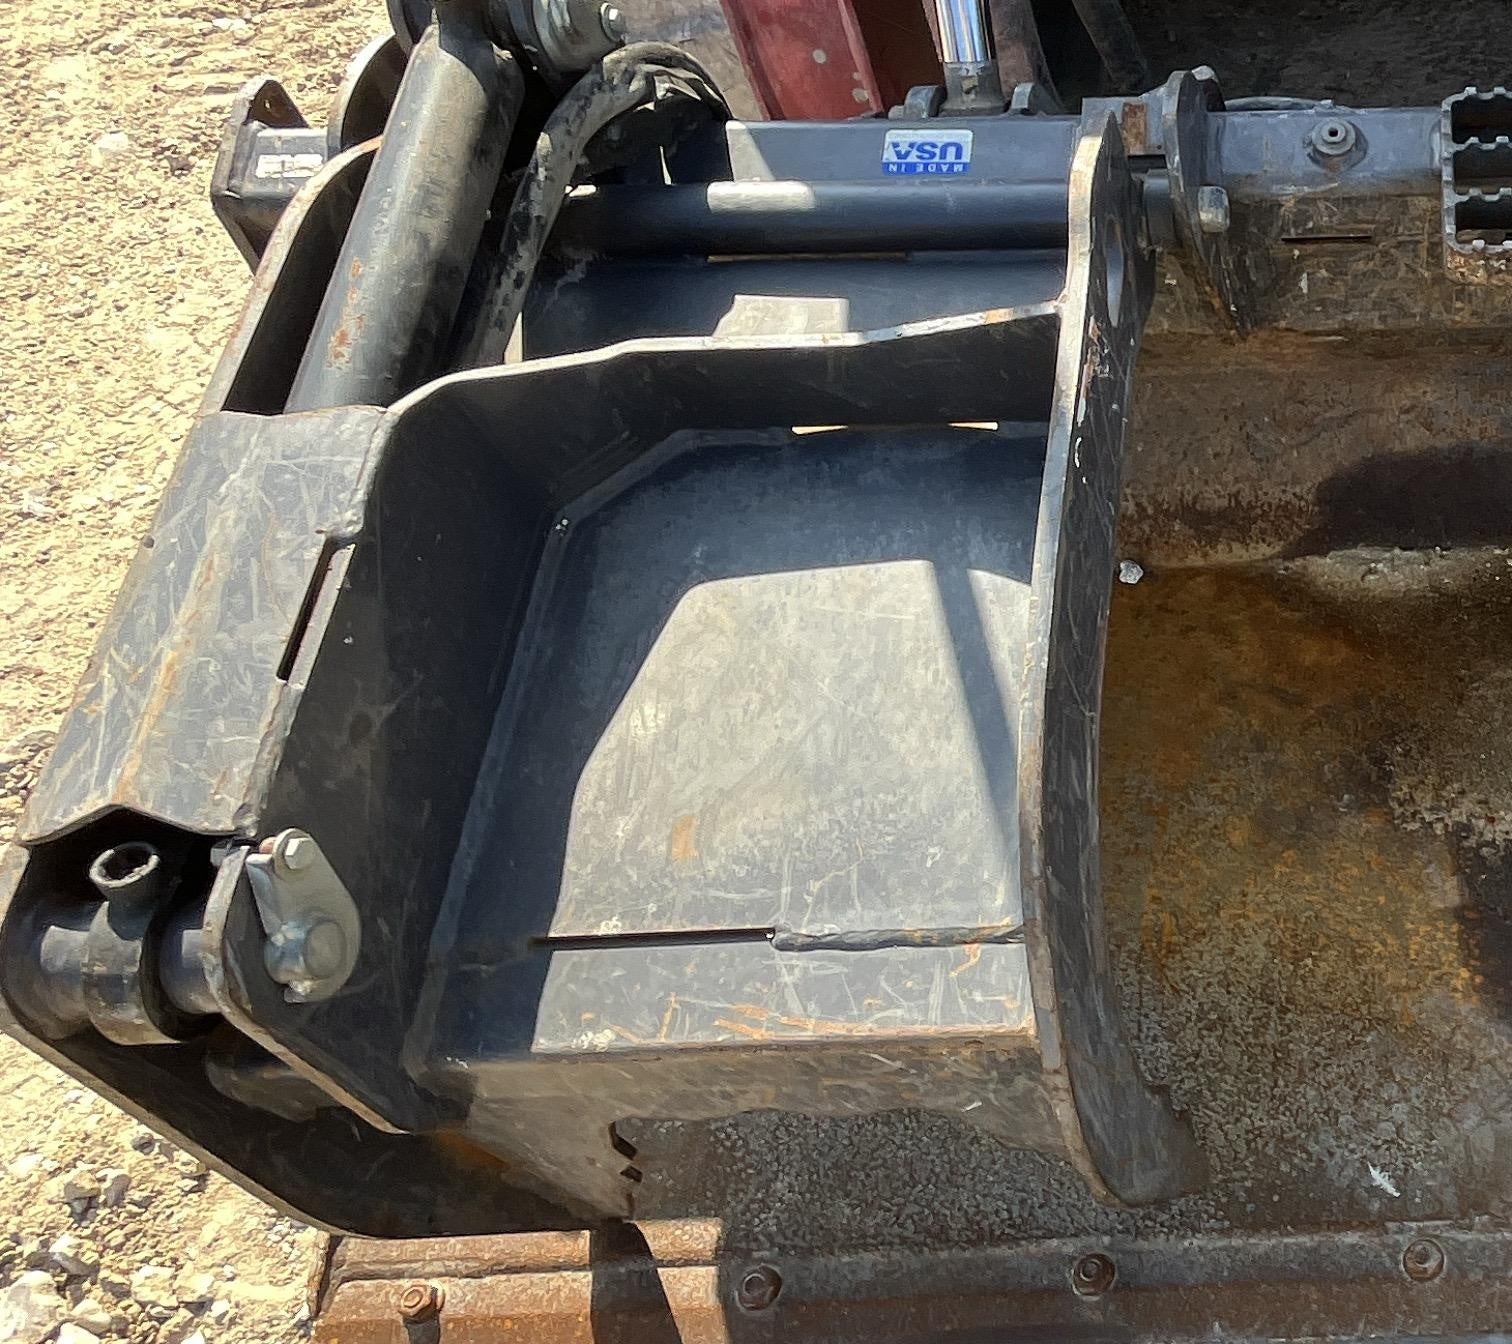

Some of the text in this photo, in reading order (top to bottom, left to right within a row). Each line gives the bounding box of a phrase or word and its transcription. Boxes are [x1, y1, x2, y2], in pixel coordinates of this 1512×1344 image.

[890, 141, 964, 161] USA
[888, 163, 964, 173] MADE IN
